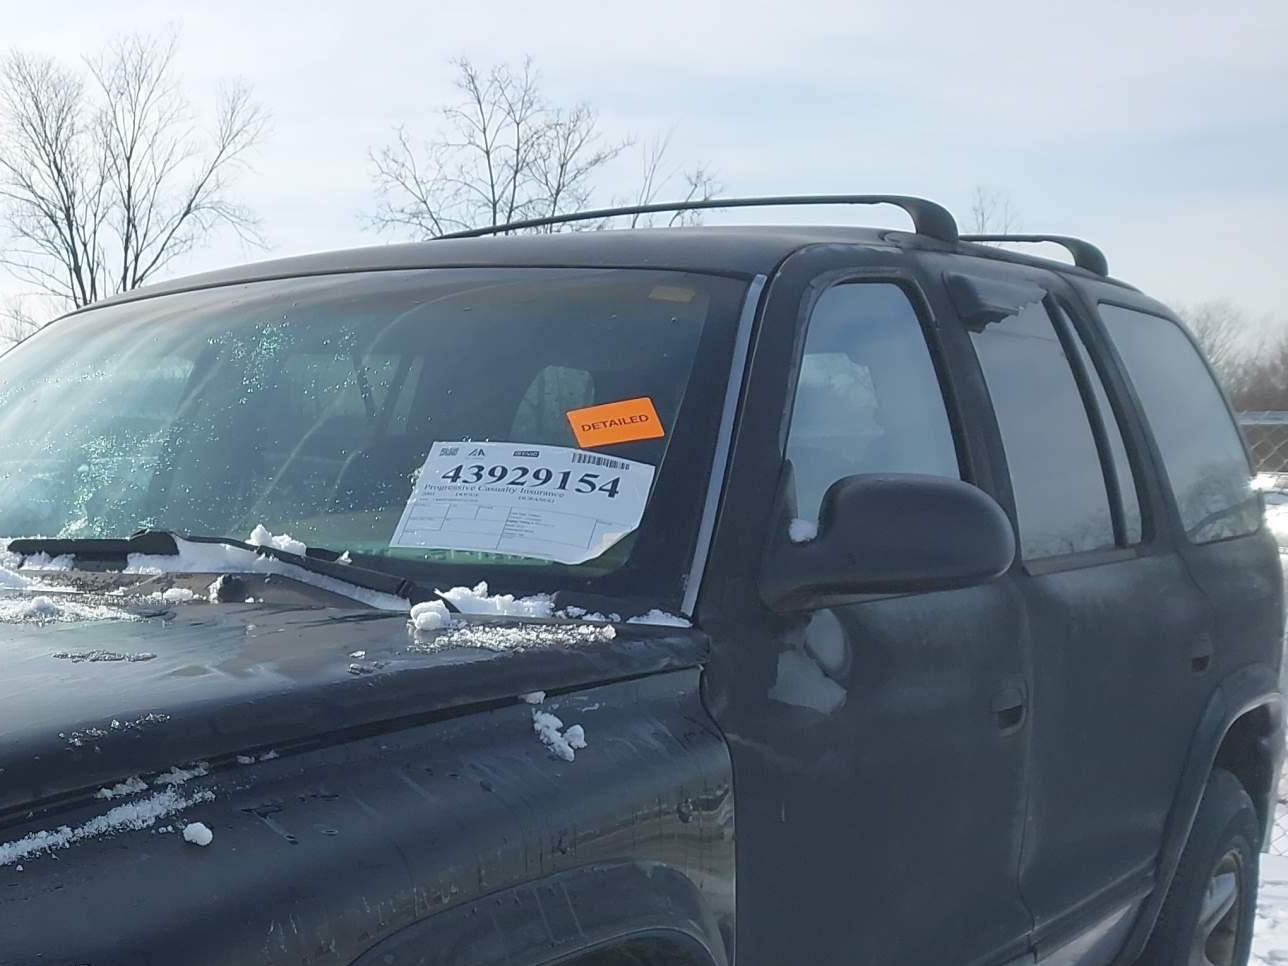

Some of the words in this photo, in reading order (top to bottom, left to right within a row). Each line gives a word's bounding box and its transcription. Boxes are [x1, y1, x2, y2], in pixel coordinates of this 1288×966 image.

[581, 414, 649, 432] DETAILED
[441, 464, 621, 498] 43929154
[424, 484, 475, 495] Progressive
[477, 485, 517, 494] Casualty
[520, 487, 565, 498] Insurance
